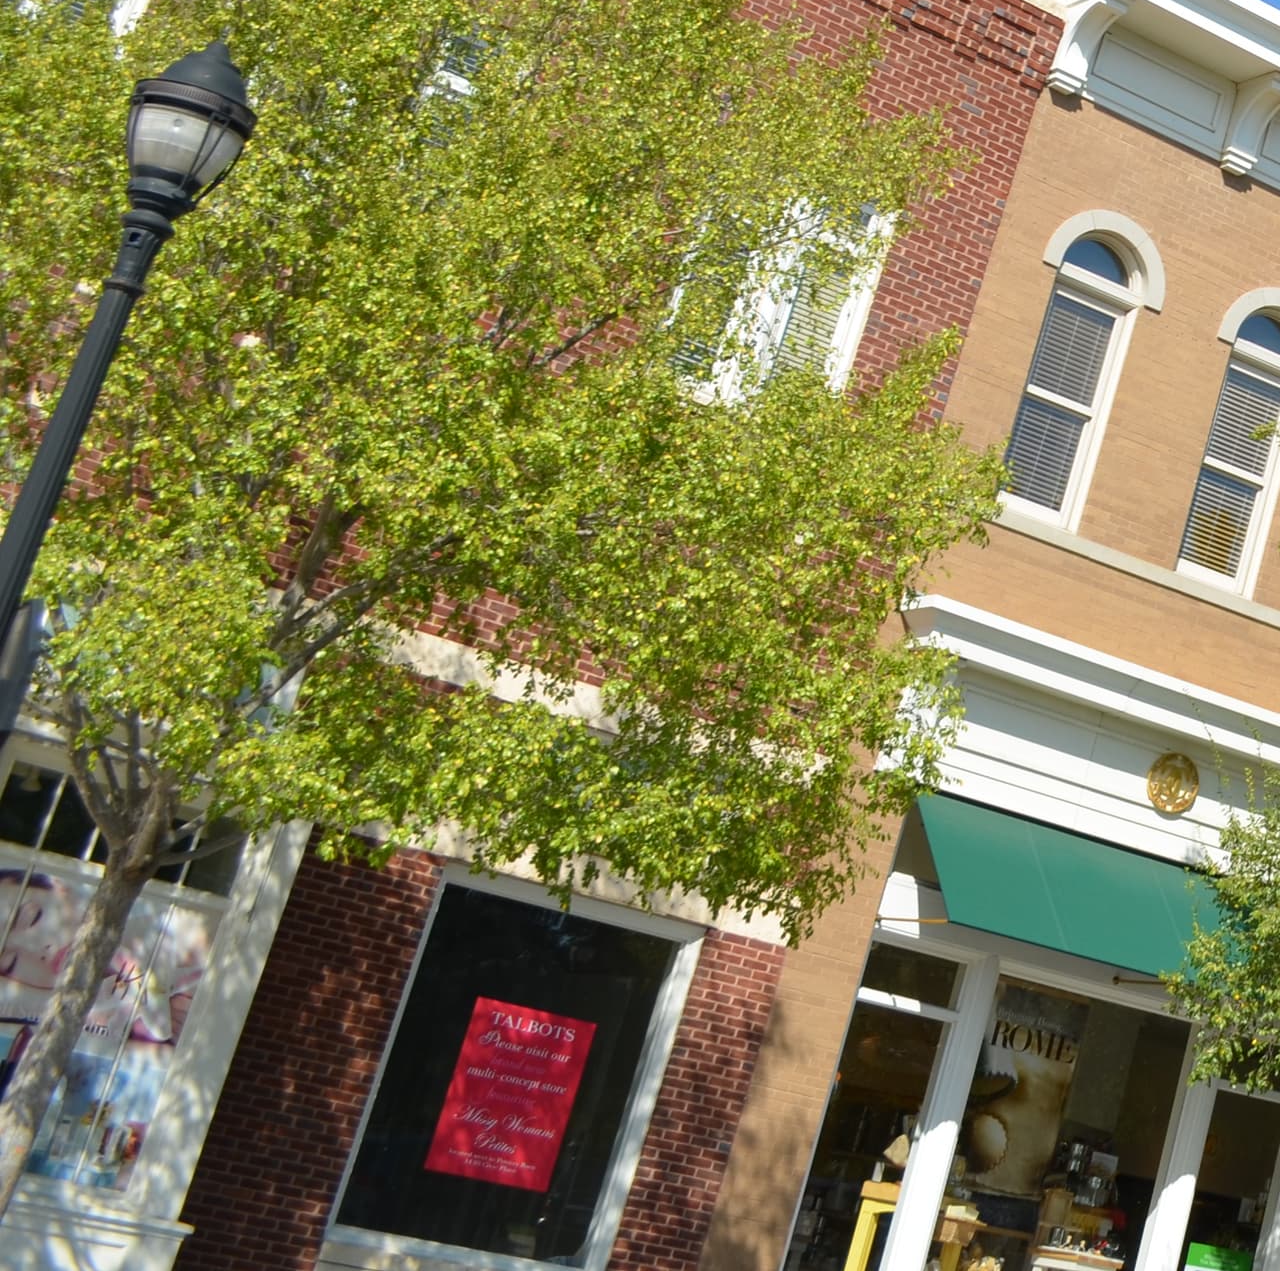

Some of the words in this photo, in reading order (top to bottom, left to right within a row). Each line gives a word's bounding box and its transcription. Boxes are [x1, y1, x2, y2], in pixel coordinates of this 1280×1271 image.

[492, 1011, 576, 1043] TALBOTS
[991, 1019, 1077, 1064] ROME
[479, 1031, 523, 1053] Please
[525, 1047, 549, 1059] visit
[550, 1052, 571, 1064] our
[541, 1080, 567, 1095] store
